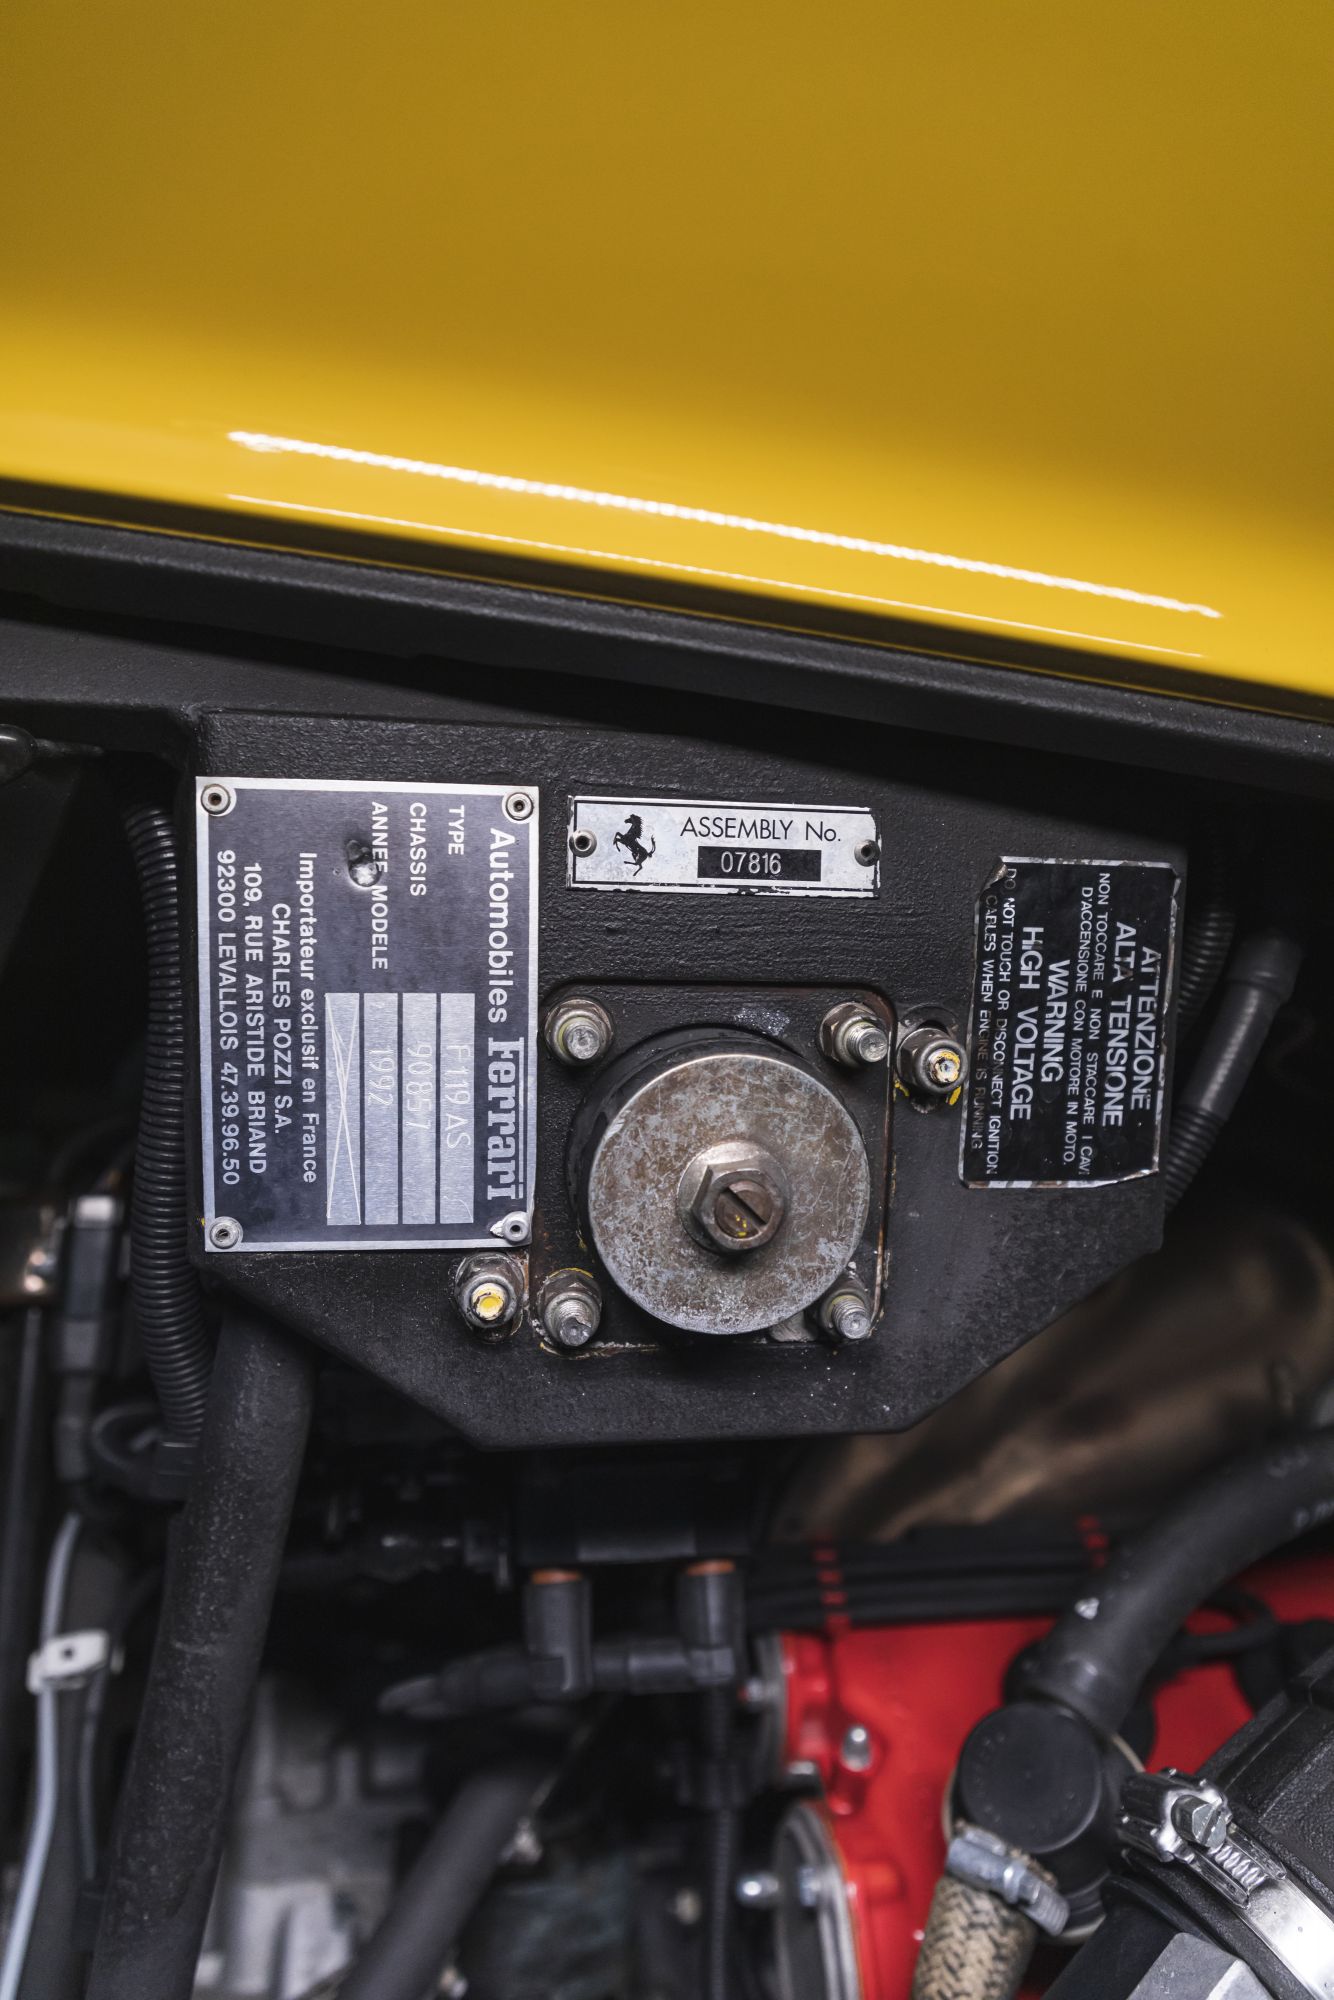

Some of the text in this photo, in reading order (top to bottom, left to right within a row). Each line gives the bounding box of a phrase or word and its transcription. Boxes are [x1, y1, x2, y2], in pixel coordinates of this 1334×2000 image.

[409, 802, 427, 896] CHASSIS
[448, 805, 464, 856] TYPE
[681, 817, 840, 842] ASSEMBLY No.
[720, 851, 782, 874] 07816
[371, 886, 388, 970] MODELE
[487, 828, 515, 1023] Automobiles
[984, 895, 998, 951] CABLES
[1098, 873, 1110, 905] NON
[981, 960, 994, 1002] WHEN
[1093, 912, 1108, 979] TOCCARE
[217, 850, 239, 1185] 92300 LEVALLOIS 47.39.96.50
[241, 863, 266, 1174] 109, RUE ARISTIDE BRIAND
[272, 903, 291, 1135] CHARLES POZZI S.A.
[296, 852, 319, 1183] Importateur exclusif en France
[977, 1010, 991, 1060] ENGINE
[987, 868, 1017, 1174] DO NOT TOUCH OR DISCONNECT IGNITION
[1010, 927, 1043, 1120] HIGH VOLTAGE
[1041, 960, 1070, 1082] WARNING
[1064, 887, 1093, 1165] D'ACCENSIONE CON MOTORE IN MOTO.
[1088, 1009, 1101, 1039] NON
[1092, 989, 1103, 998] E
[1102, 922, 1136, 1127] ALTA TENSIONE
[1130, 947, 1162, 1111] ATTENZIONE
[367, 1047, 395, 1106] 1992
[976, 1068, 987, 1080] IS
[1083, 1053, 1098, 1124] STACCARE
[487, 1037, 524, 1200] Ferrari
